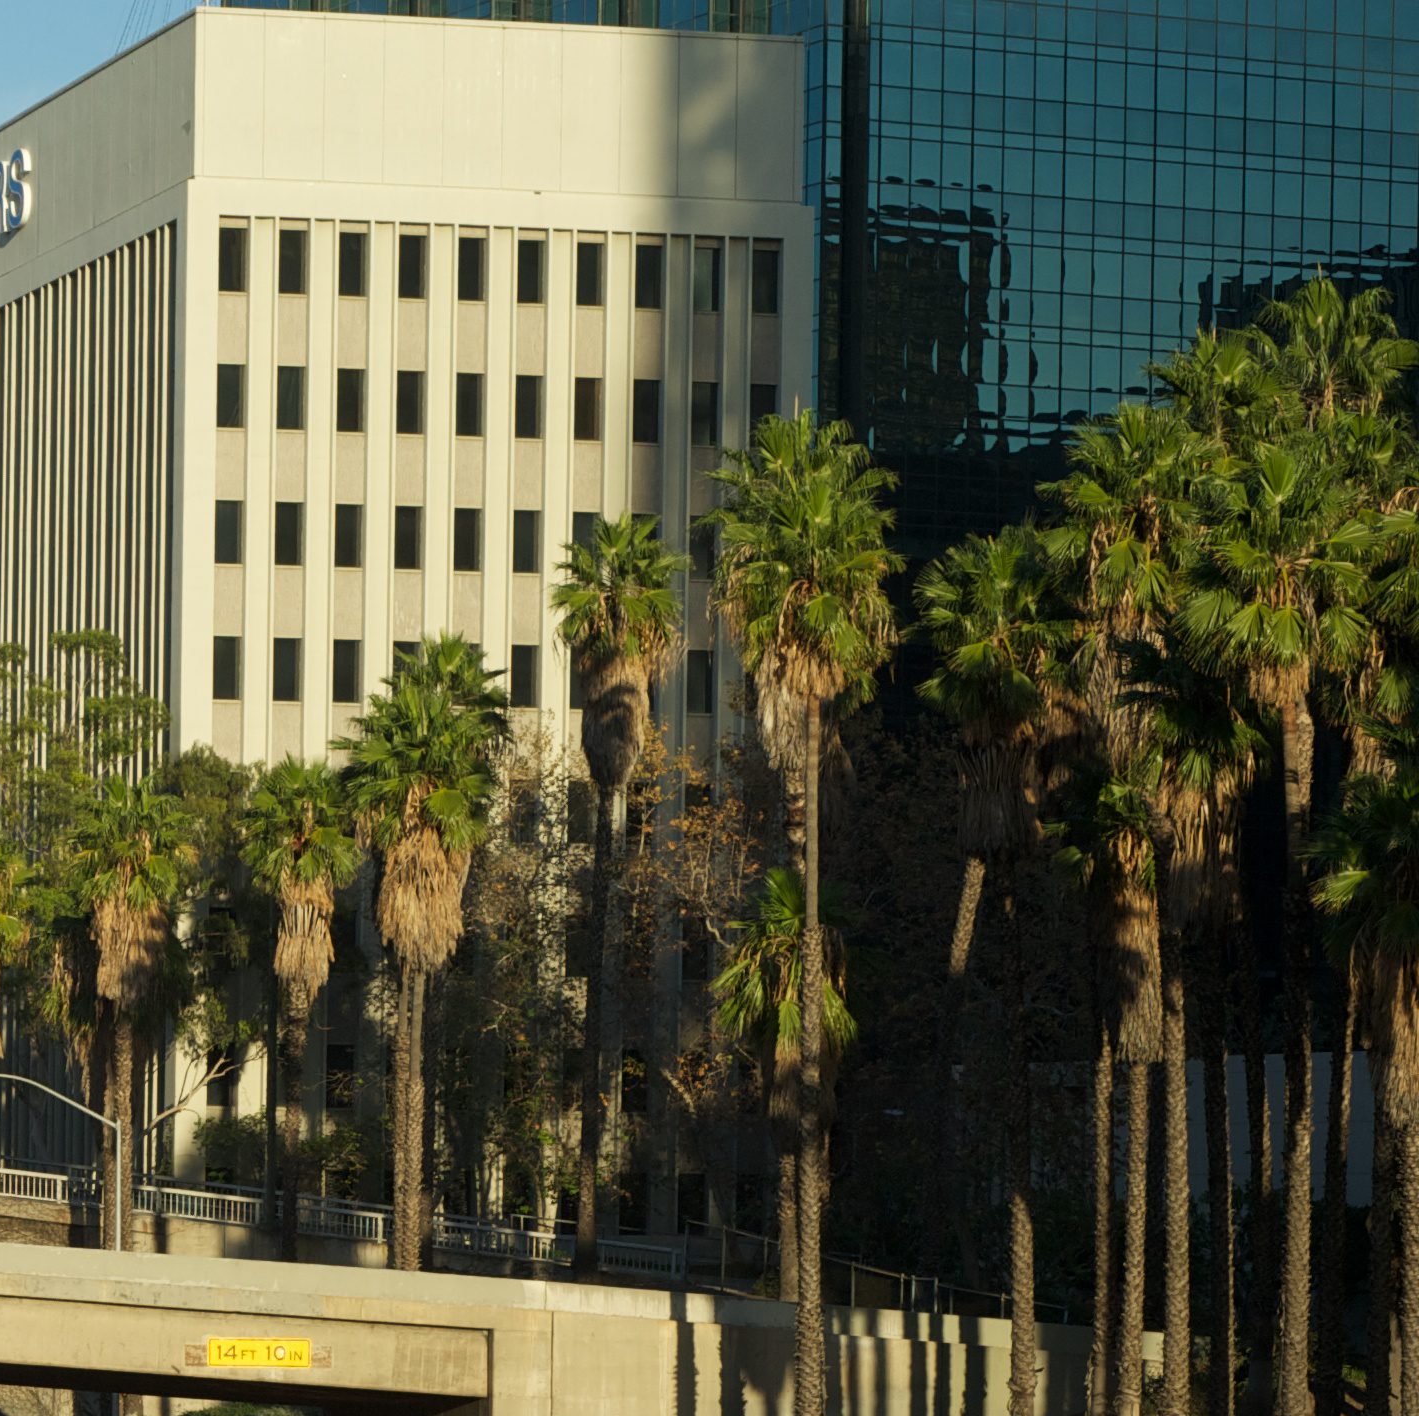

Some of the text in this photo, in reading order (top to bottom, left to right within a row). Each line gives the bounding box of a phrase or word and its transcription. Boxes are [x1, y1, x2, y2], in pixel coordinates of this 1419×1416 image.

[217, 1345, 302, 1361] 14 FT 10 IN
